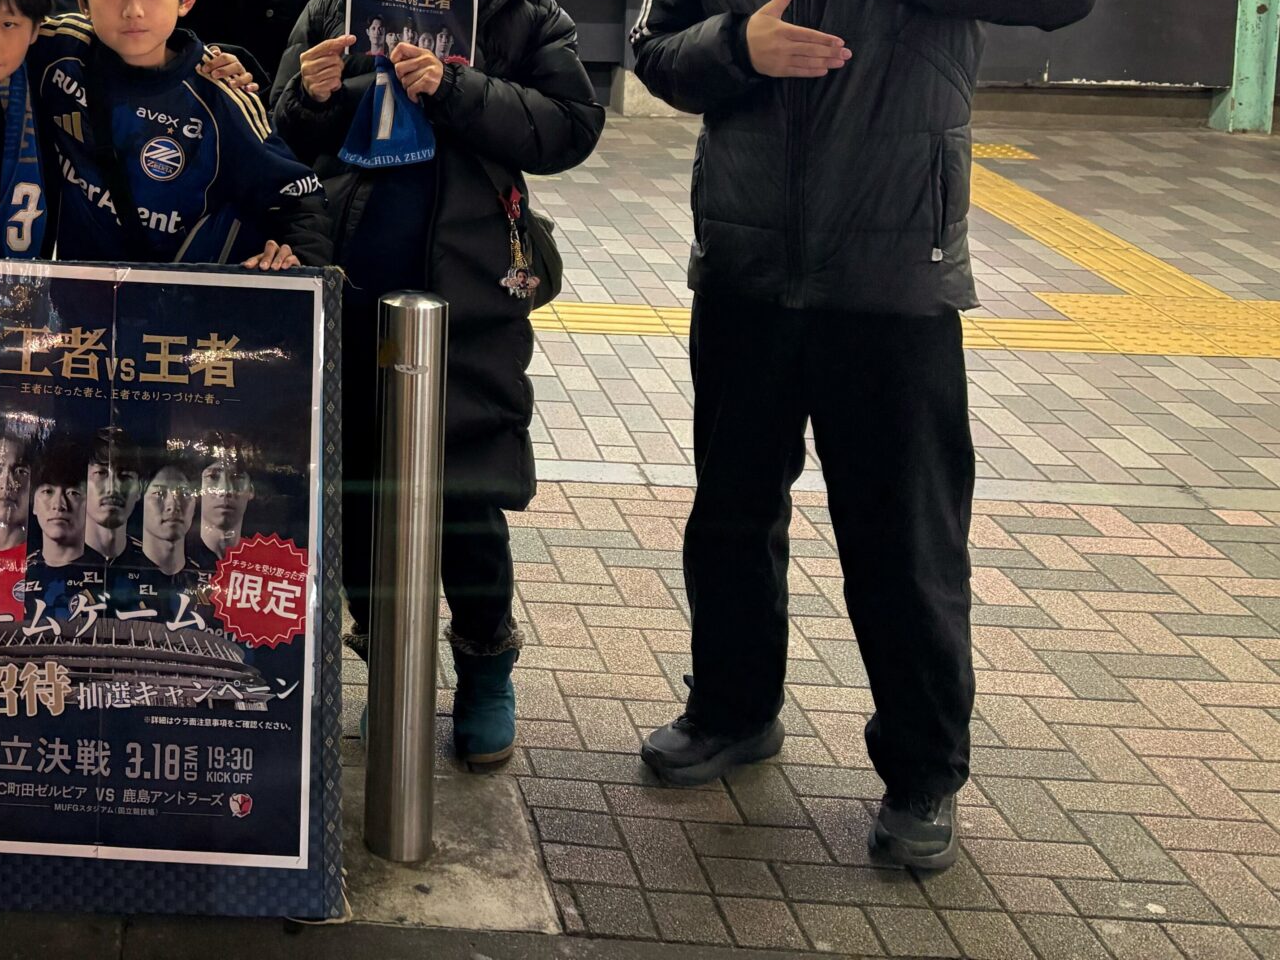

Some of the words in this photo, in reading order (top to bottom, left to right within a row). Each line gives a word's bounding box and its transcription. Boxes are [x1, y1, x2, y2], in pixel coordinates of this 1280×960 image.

[136, 107, 180, 128] avex
[226, 571, 303, 620] 限定
[76, 678, 301, 712] 抽選キャンペーン
[125, 741, 181, 782] 3.18
[184, 745, 199, 781] WED
[207, 745, 254, 772] 19:30
[206, 771, 231, 784] KICK
[233, 772, 253, 785] OFF
[96, 788, 116, 803] VS
[122, 789, 223, 807] 鹿島アントラーズ
